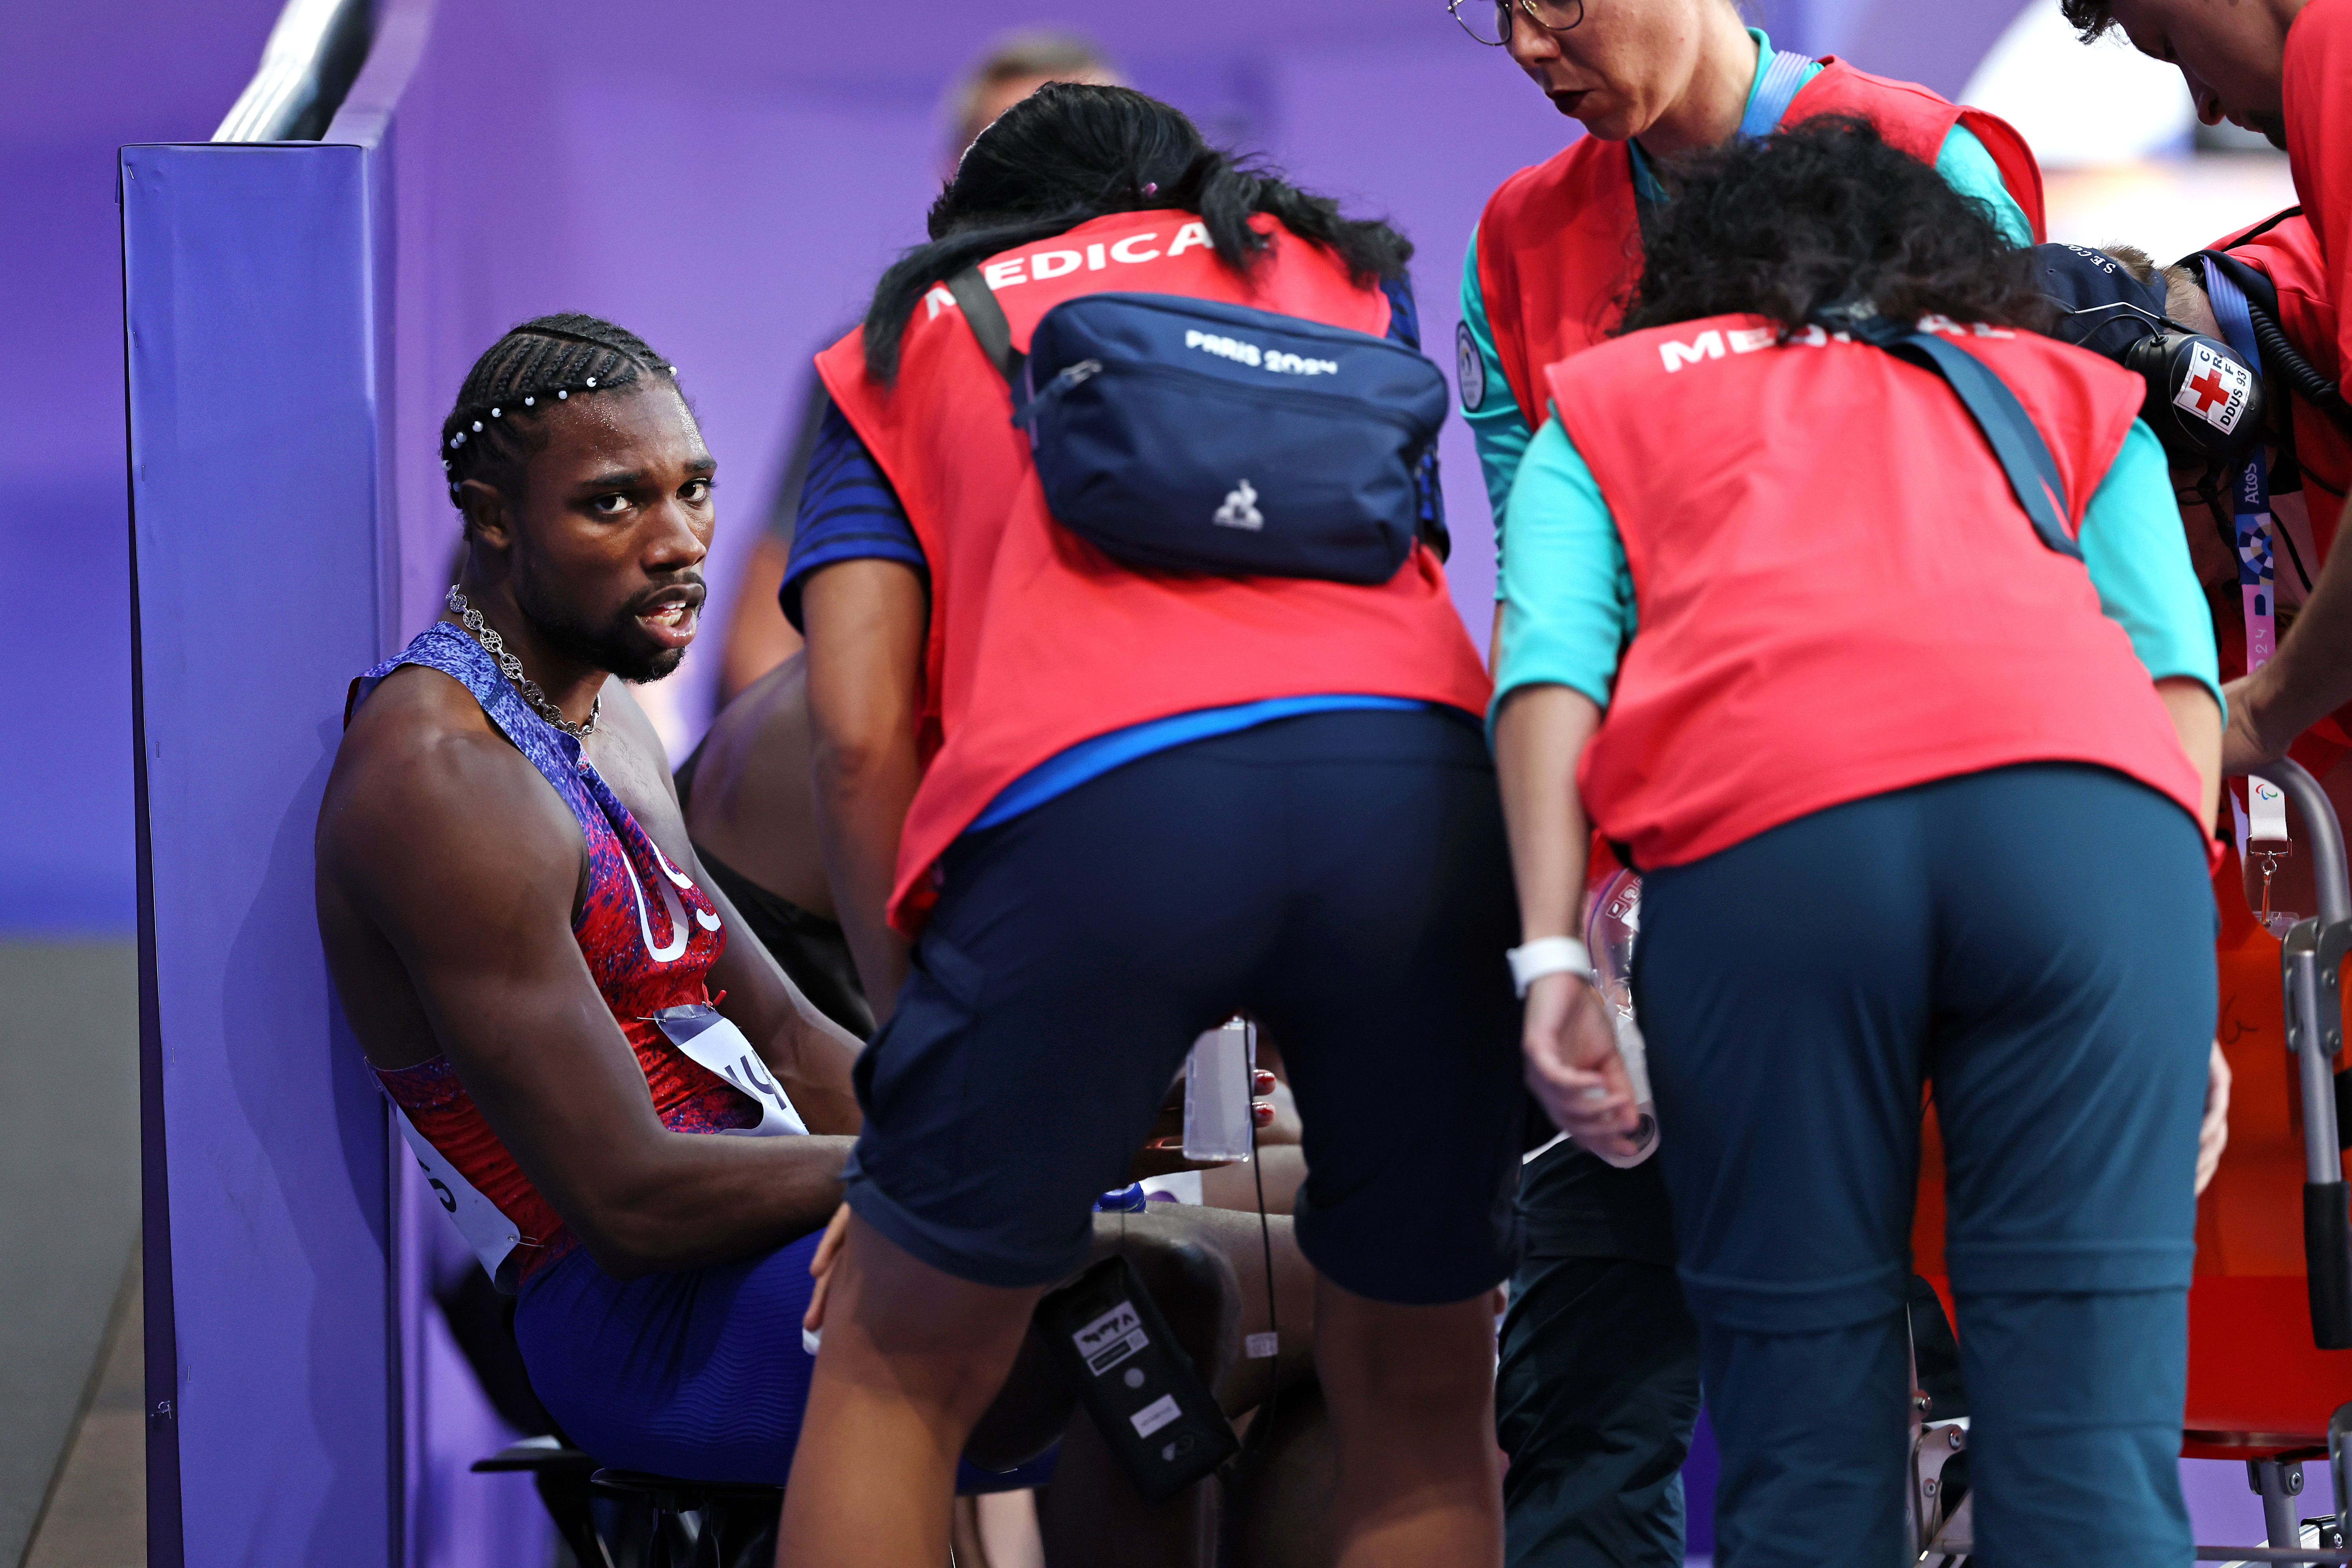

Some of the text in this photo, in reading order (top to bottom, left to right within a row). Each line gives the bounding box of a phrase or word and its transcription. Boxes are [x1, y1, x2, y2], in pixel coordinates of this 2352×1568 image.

[925, 221, 1269, 321] MEDICA
[2061, 243, 2116, 274] SECO
[1185, 329, 1338, 375] PARIS 2024
[2220, 370, 2247, 426] DDUS 93
[2244, 463, 2259, 505] Atos
